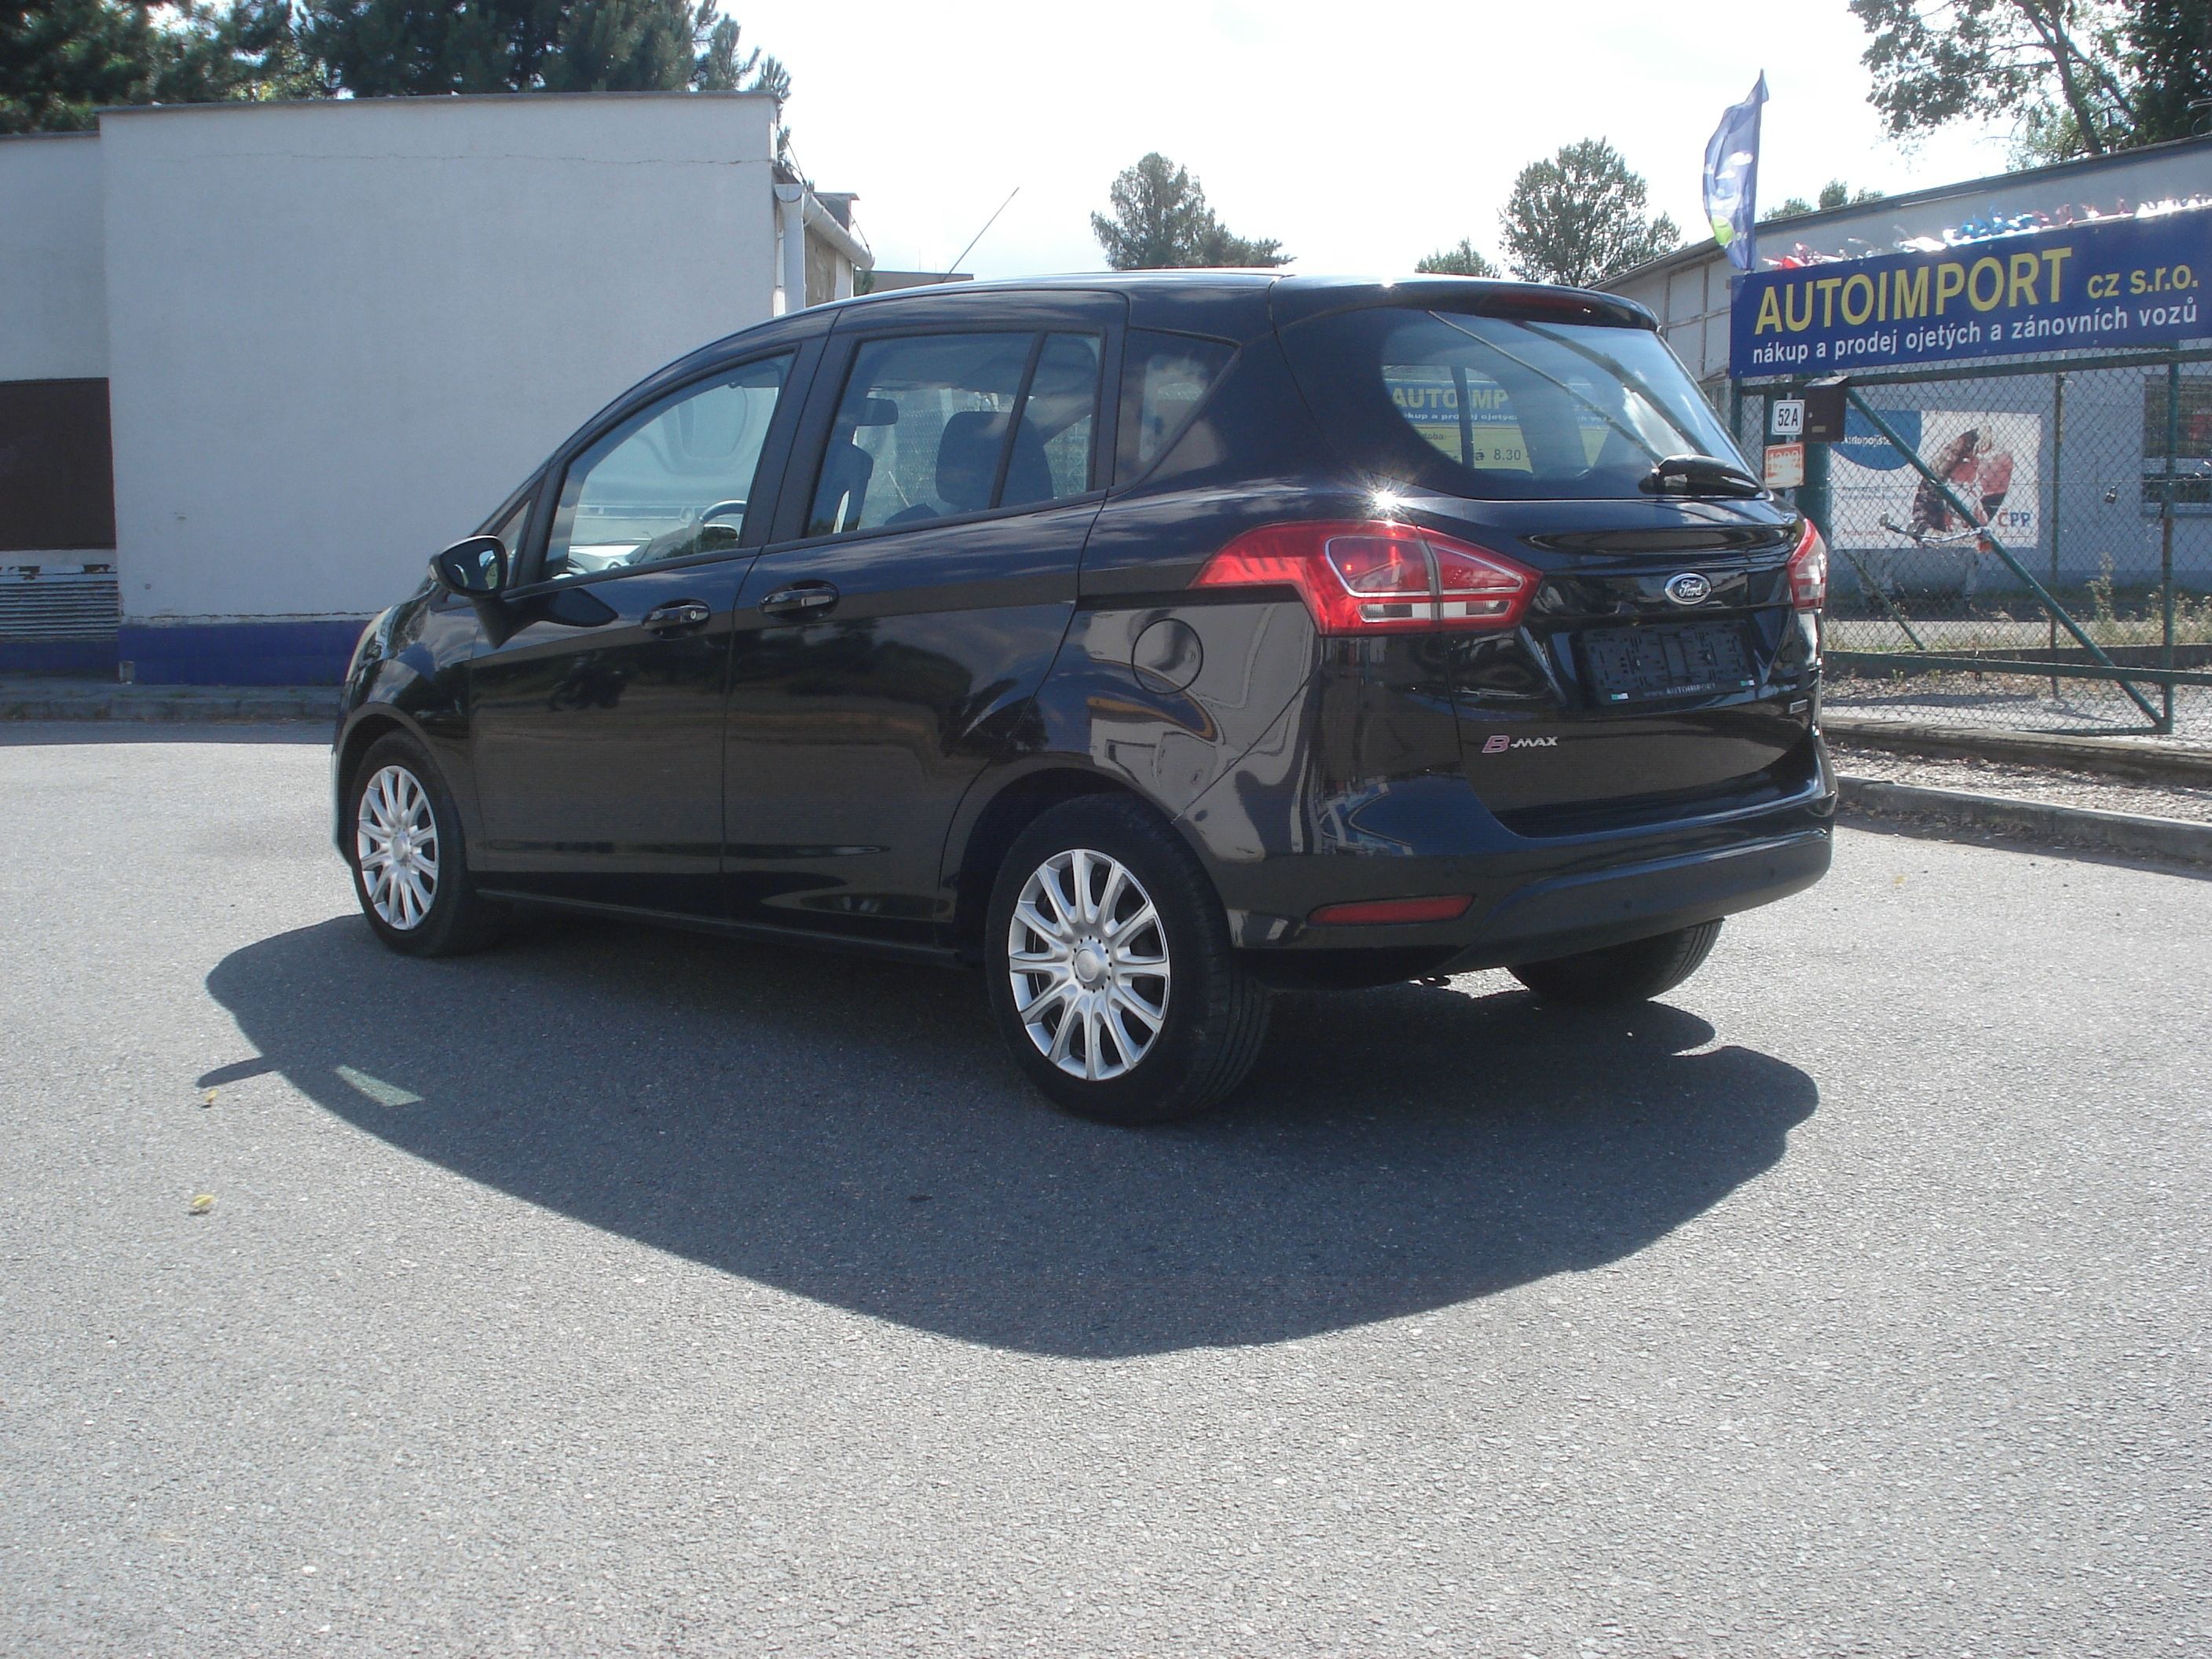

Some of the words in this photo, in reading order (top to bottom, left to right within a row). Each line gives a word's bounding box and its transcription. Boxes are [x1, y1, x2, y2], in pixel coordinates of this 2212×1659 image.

[1753, 247, 2072, 335] AUTOIMPORT
[2087, 273, 2120, 299] cz
[2130, 265, 2199, 295] s.r.o.
[1752, 341, 1808, 364] nákup
[1816, 342, 1827, 358] a
[1834, 328, 1898, 361] prodej
[1906, 320, 1980, 353] ojetých
[1990, 324, 2002, 342] a
[2011, 306, 2128, 340] zánovních
[2139, 295, 2198, 328] vozů
[1392, 387, 1509, 409] AUTOMP
[1493, 449, 1522, 461] 8.30
[1679, 579, 1703, 598] Ford
